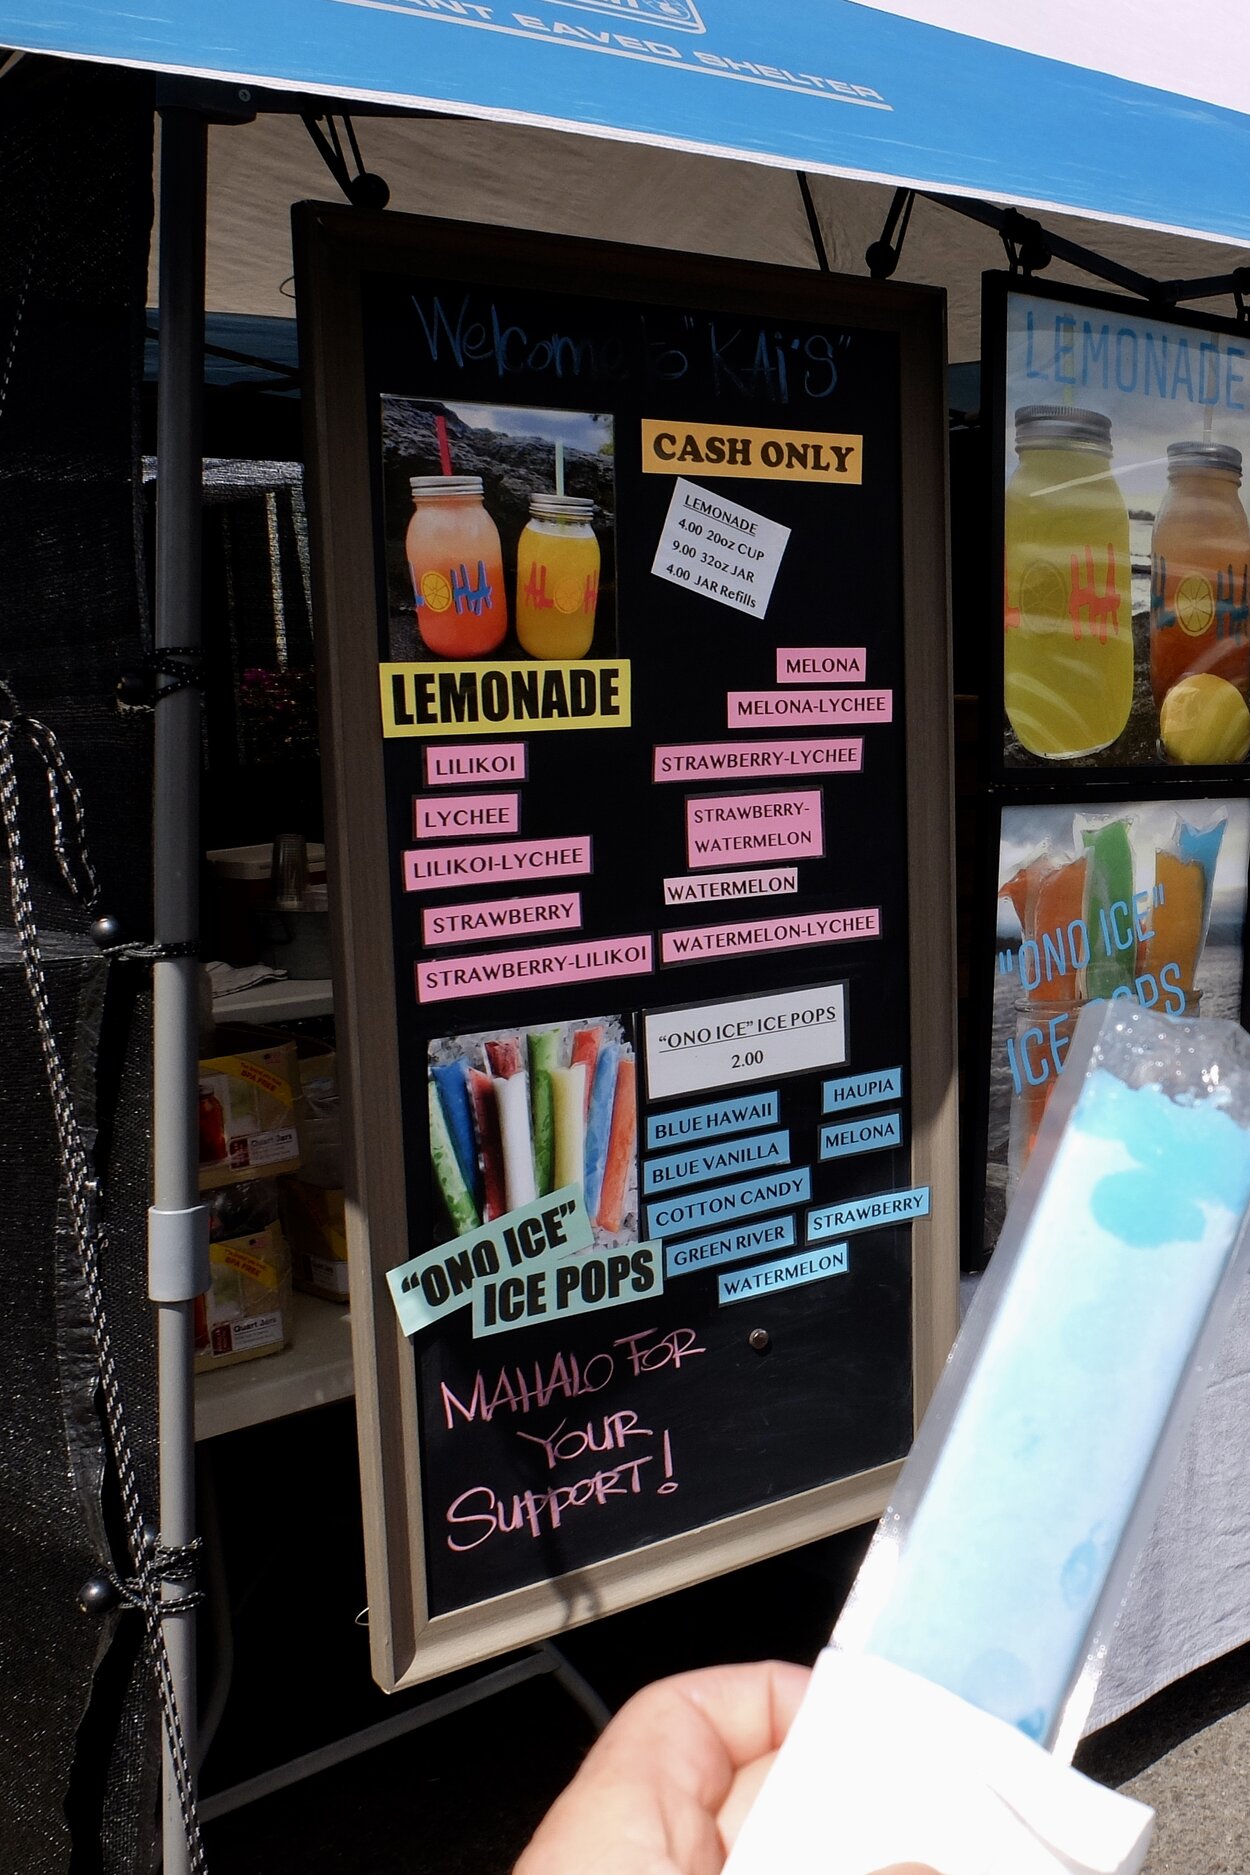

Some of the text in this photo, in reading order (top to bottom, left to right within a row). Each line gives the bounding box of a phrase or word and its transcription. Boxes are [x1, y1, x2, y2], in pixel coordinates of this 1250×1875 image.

[511, 12, 683, 60] EAVED
[693, 50, 885, 101] SHELTER
[1025, 309, 1246, 412] LEMONADE
[652, 432, 855, 473] CASH ONLY
[684, 494, 759, 536] LEMONADE
[678, 518, 765, 561] 4.00 20oz CUP
[672, 540, 756, 583] 9.00 32oz JAR
[666, 564, 757, 608] 4.00 JAR Refills
[785, 656, 861, 675] MELONA
[390, 667, 622, 727] LEMONADE
[737, 696, 887, 717] MELONA-LYCHEE
[435, 755, 516, 777] LILIKOI
[661, 747, 858, 772] STRAWBERRY-LYCHEE
[424, 806, 511, 829] LYCHEE
[693, 802, 811, 824] STRAWBERRY-
[694, 829, 813, 854] WATERMELON
[413, 846, 584, 880] LILIKOI-LYCHEE
[667, 875, 797, 902] WATERMELON
[433, 902, 574, 935] STRAWBERRY
[672, 914, 876, 954] WATERMELON-LYCHEE
[998, 883, 1166, 993] "ONO ICE"
[425, 945, 648, 990] STRAWBERRY-LILIKOI
[757, 1013, 788, 1033] ICE
[790, 1005, 837, 1028] POPS
[731, 1048, 765, 1070] 2.00
[256, 1078, 277, 1092] FREE
[833, 1077, 895, 1104] HAUPIA
[654, 1102, 773, 1141] BLUE HAWAII
[825, 1122, 895, 1150] MELONA
[652, 1141, 780, 1185] BLUE VANILLA
[655, 1178, 804, 1228] COTTON CANDY
[812, 1194, 924, 1233] STRAWBERRY
[673, 1226, 786, 1267] GREEN RIVER
[240, 1263, 262, 1278] FREE
[482, 1249, 656, 1329] ICE POPS
[724, 1252, 845, 1297] WATERMELON
[234, 1321, 258, 1333] Quart
[440, 1352, 615, 1430] MAHALO
[516, 1409, 654, 1470] YOUR
